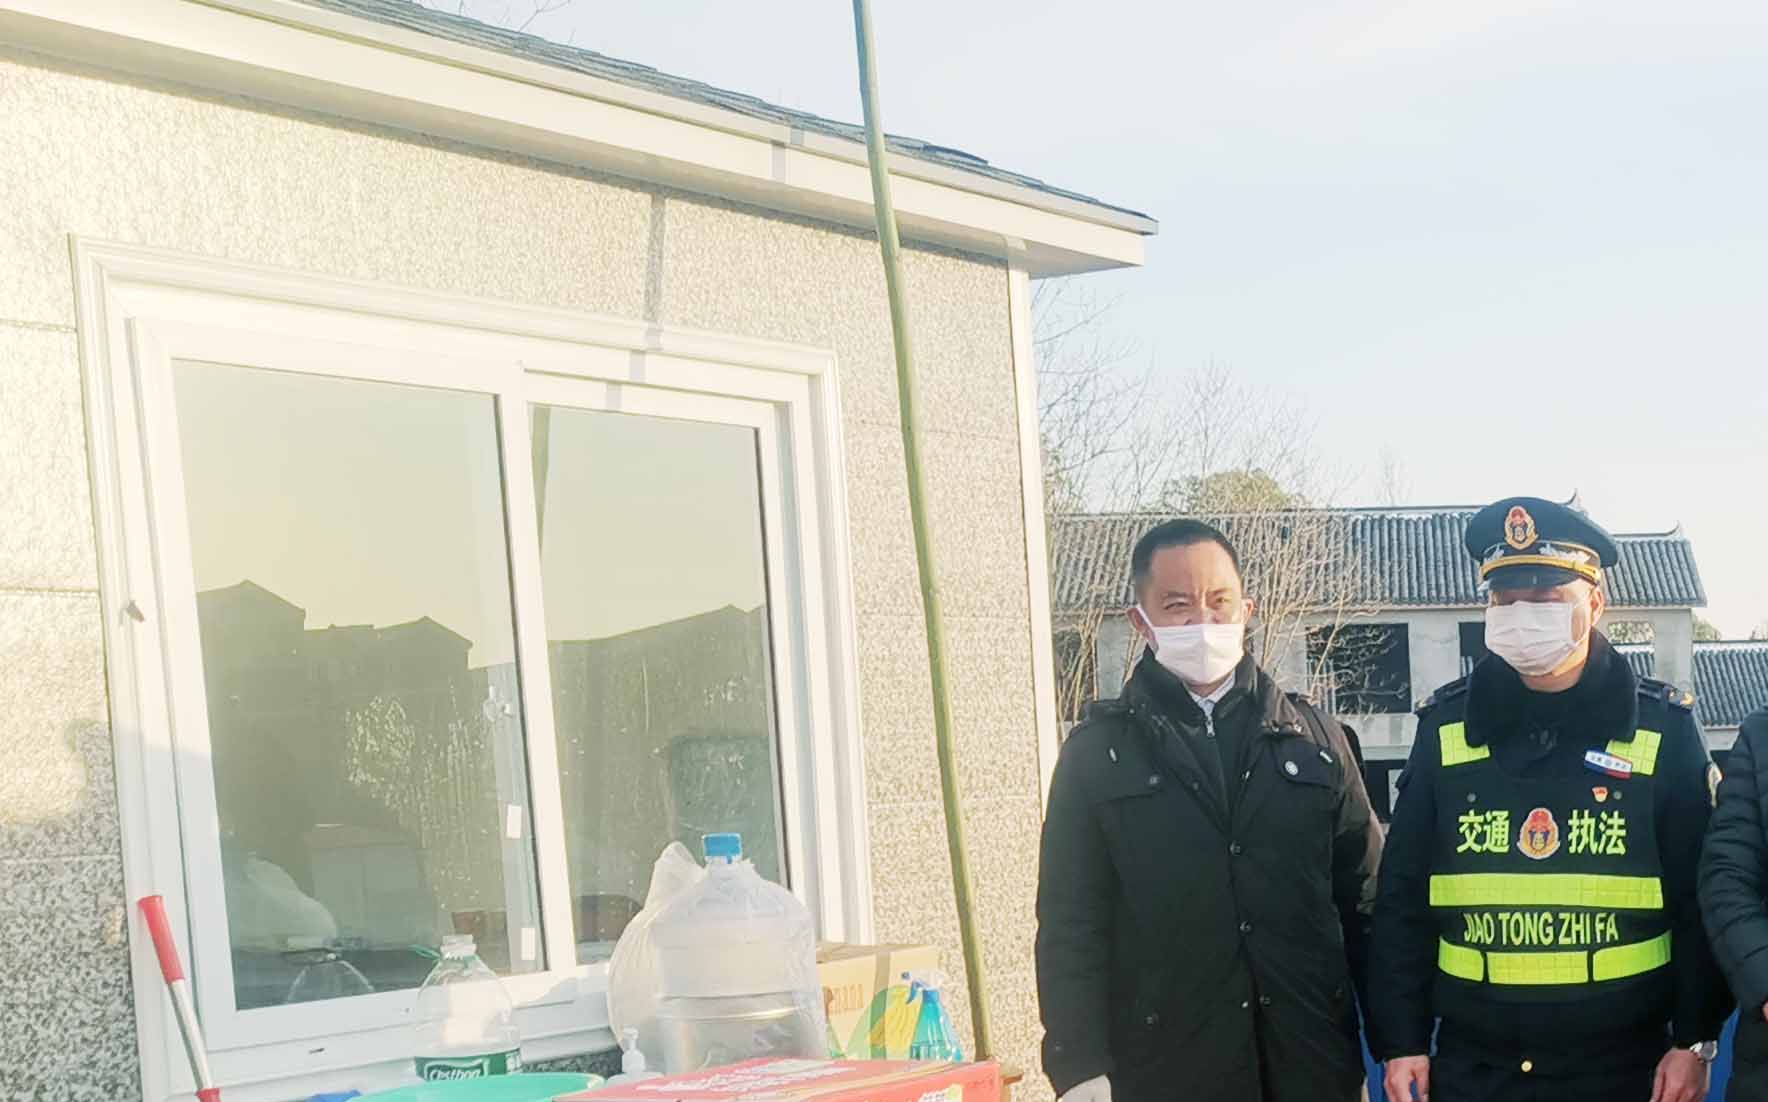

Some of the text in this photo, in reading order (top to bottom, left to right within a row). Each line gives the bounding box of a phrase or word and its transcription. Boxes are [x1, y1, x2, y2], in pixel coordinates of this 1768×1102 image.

[1456, 809, 1627, 855] 交通 执法
[1463, 911, 1619, 945] JIAO TONG ZHI FA
